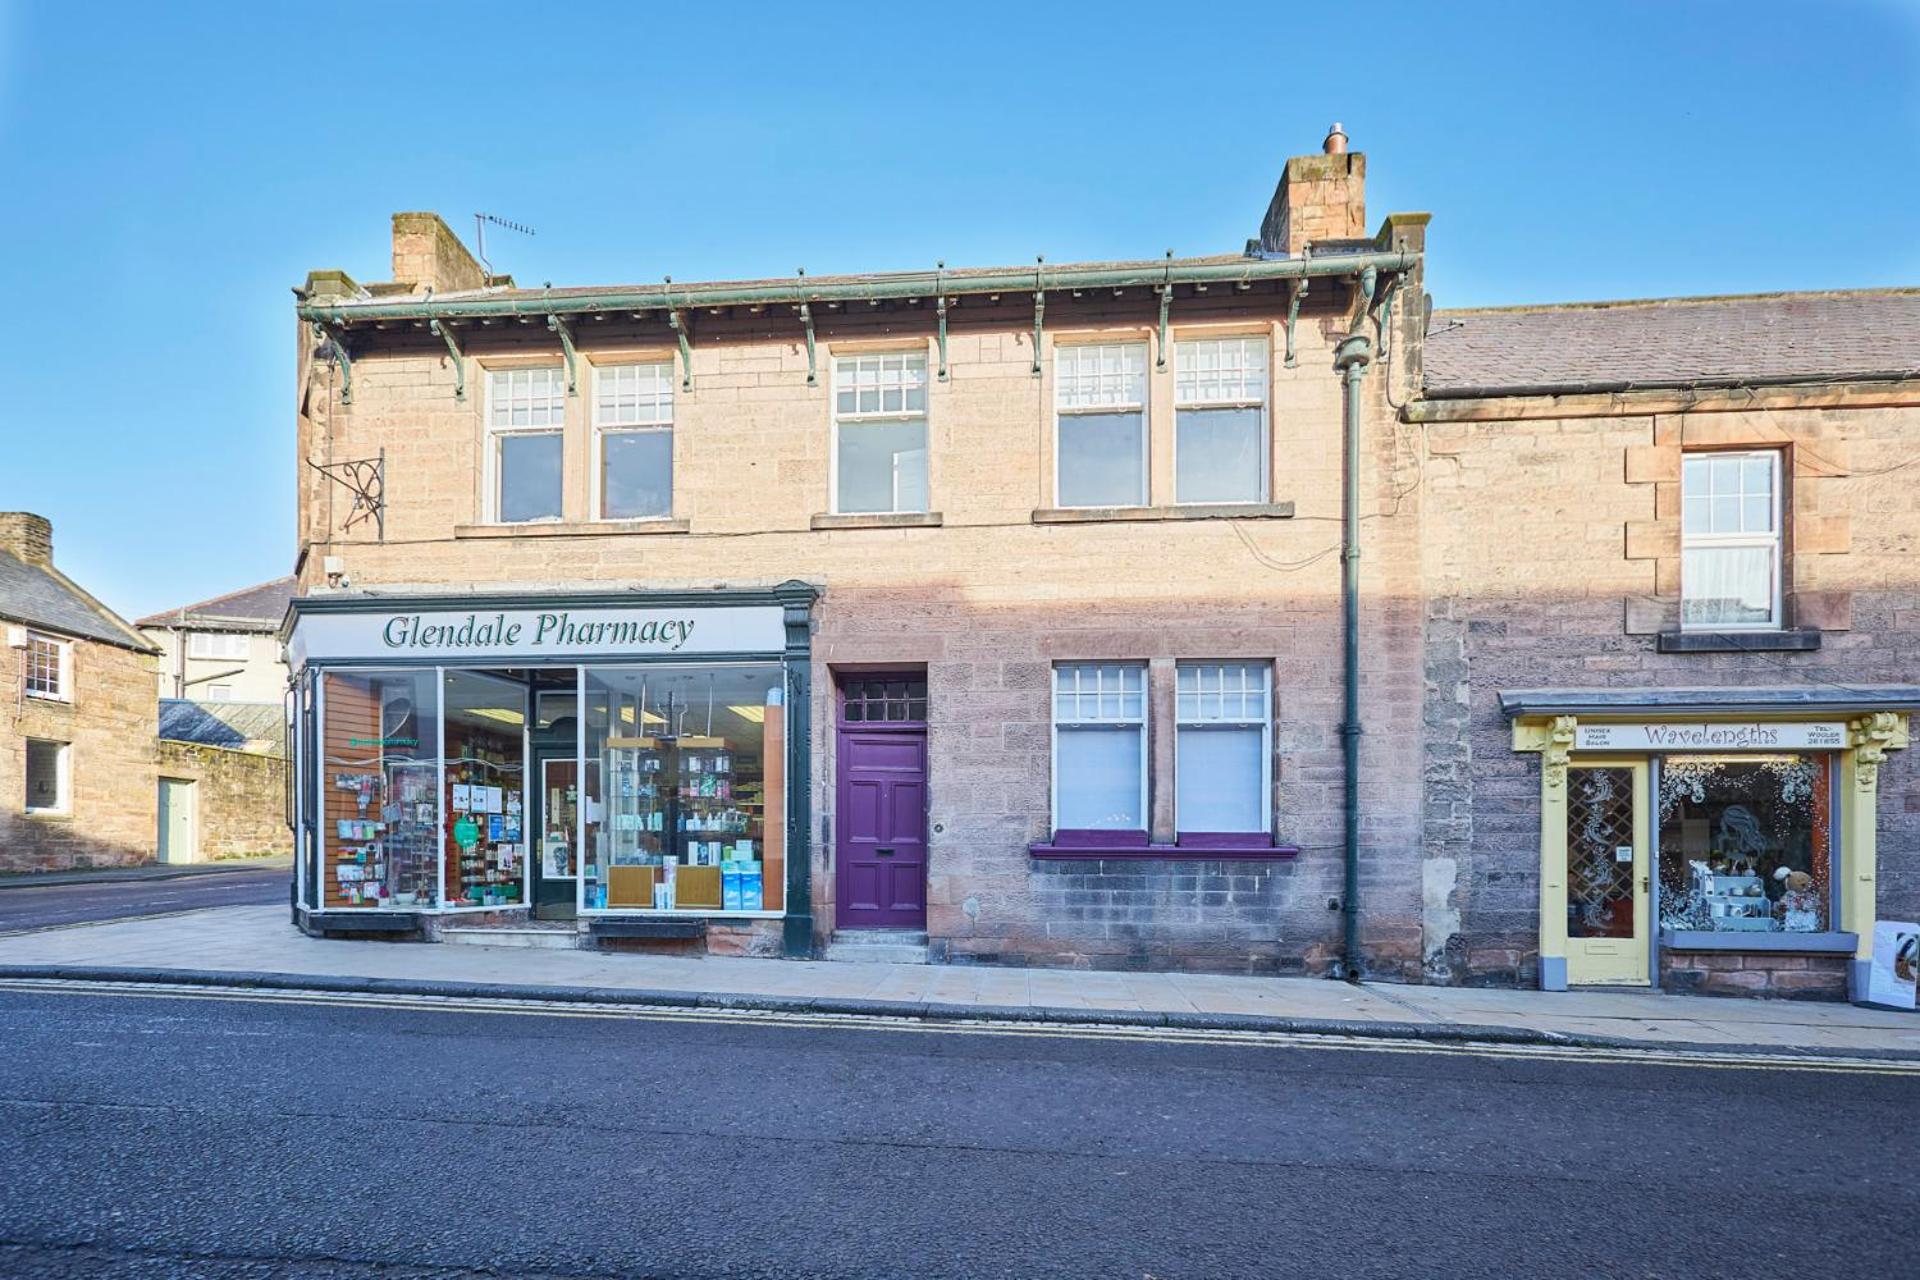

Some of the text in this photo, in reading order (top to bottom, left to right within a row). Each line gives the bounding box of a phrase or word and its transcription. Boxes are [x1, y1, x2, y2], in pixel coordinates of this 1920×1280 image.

[382, 612, 695, 651] Glendale Pharmacy
[1644, 722, 1779, 747] Wavelengths
